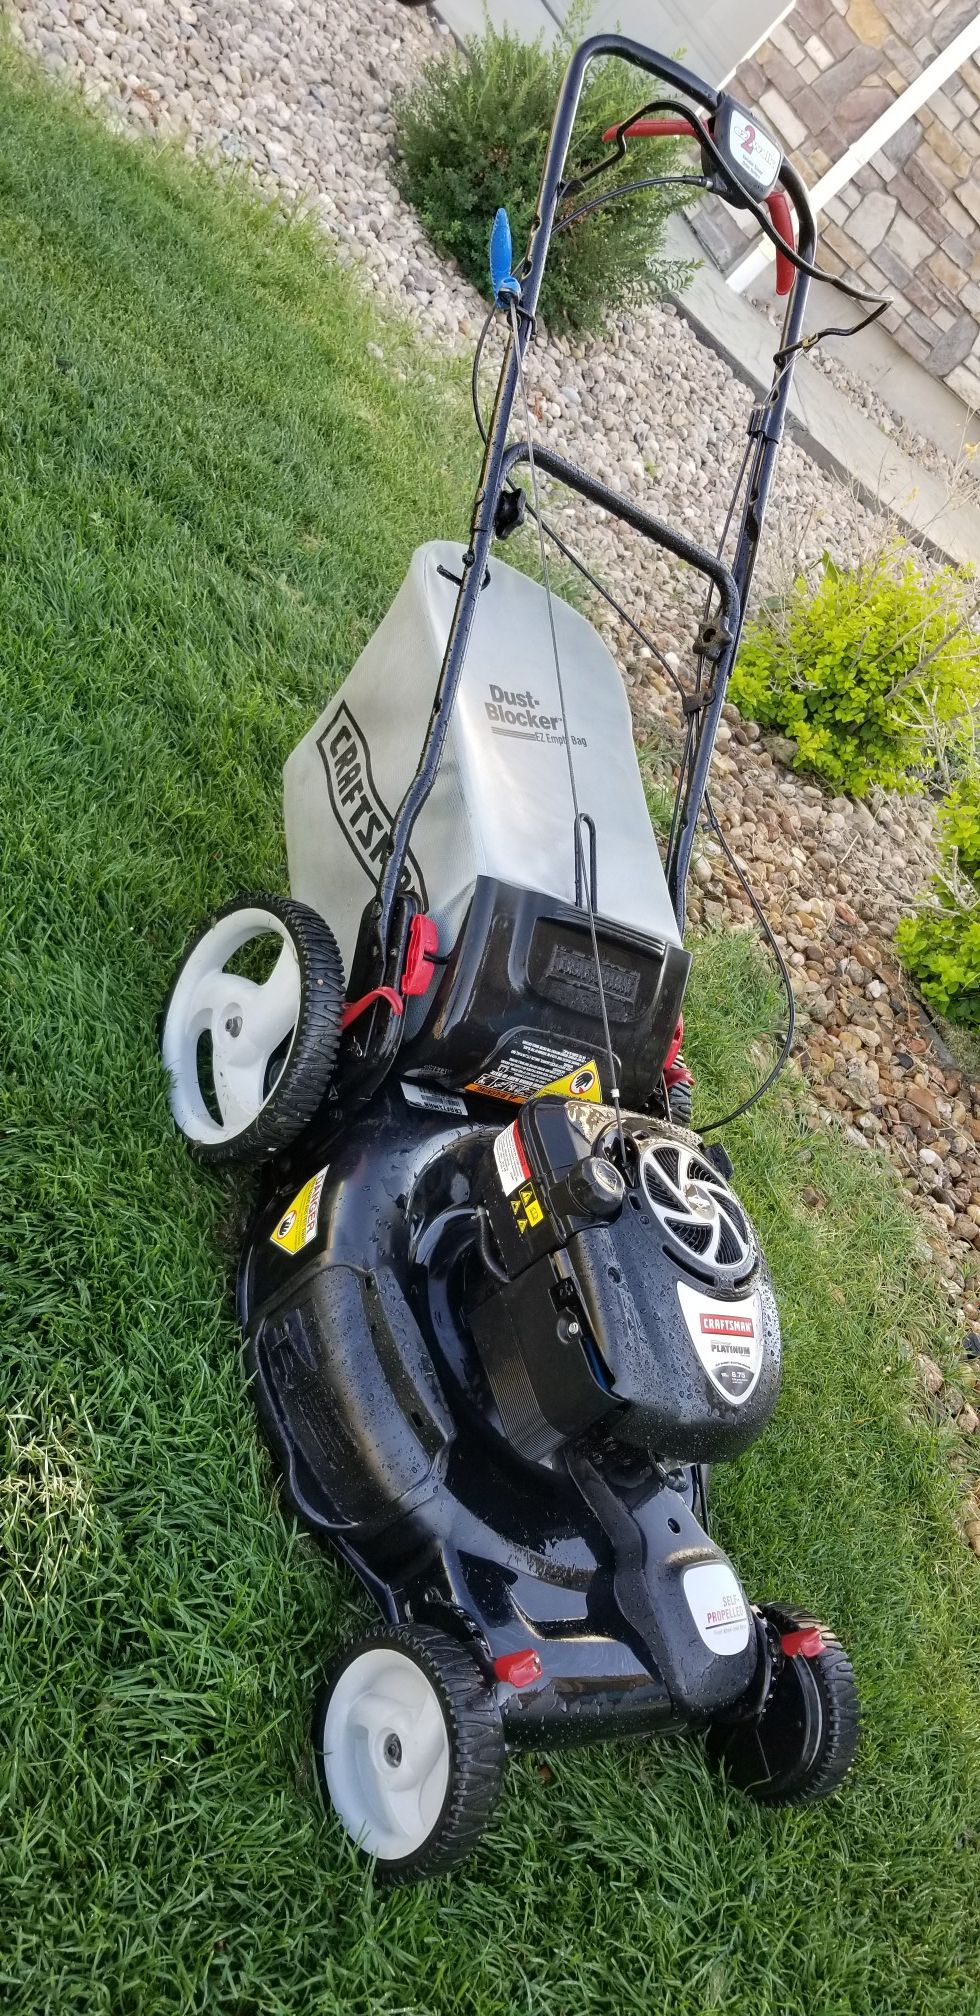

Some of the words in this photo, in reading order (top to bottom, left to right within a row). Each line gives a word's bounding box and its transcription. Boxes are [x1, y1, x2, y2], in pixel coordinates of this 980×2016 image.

[571, 735, 588, 748] Bag
[329, 724, 416, 893] CRAFTSM
[306, 1173, 325, 1234] DANGER
[703, 1317, 752, 1333] CRAFTSMAN
[711, 1343, 751, 1355] PLATINUM
[706, 1607, 744, 1625] PROPELLED
